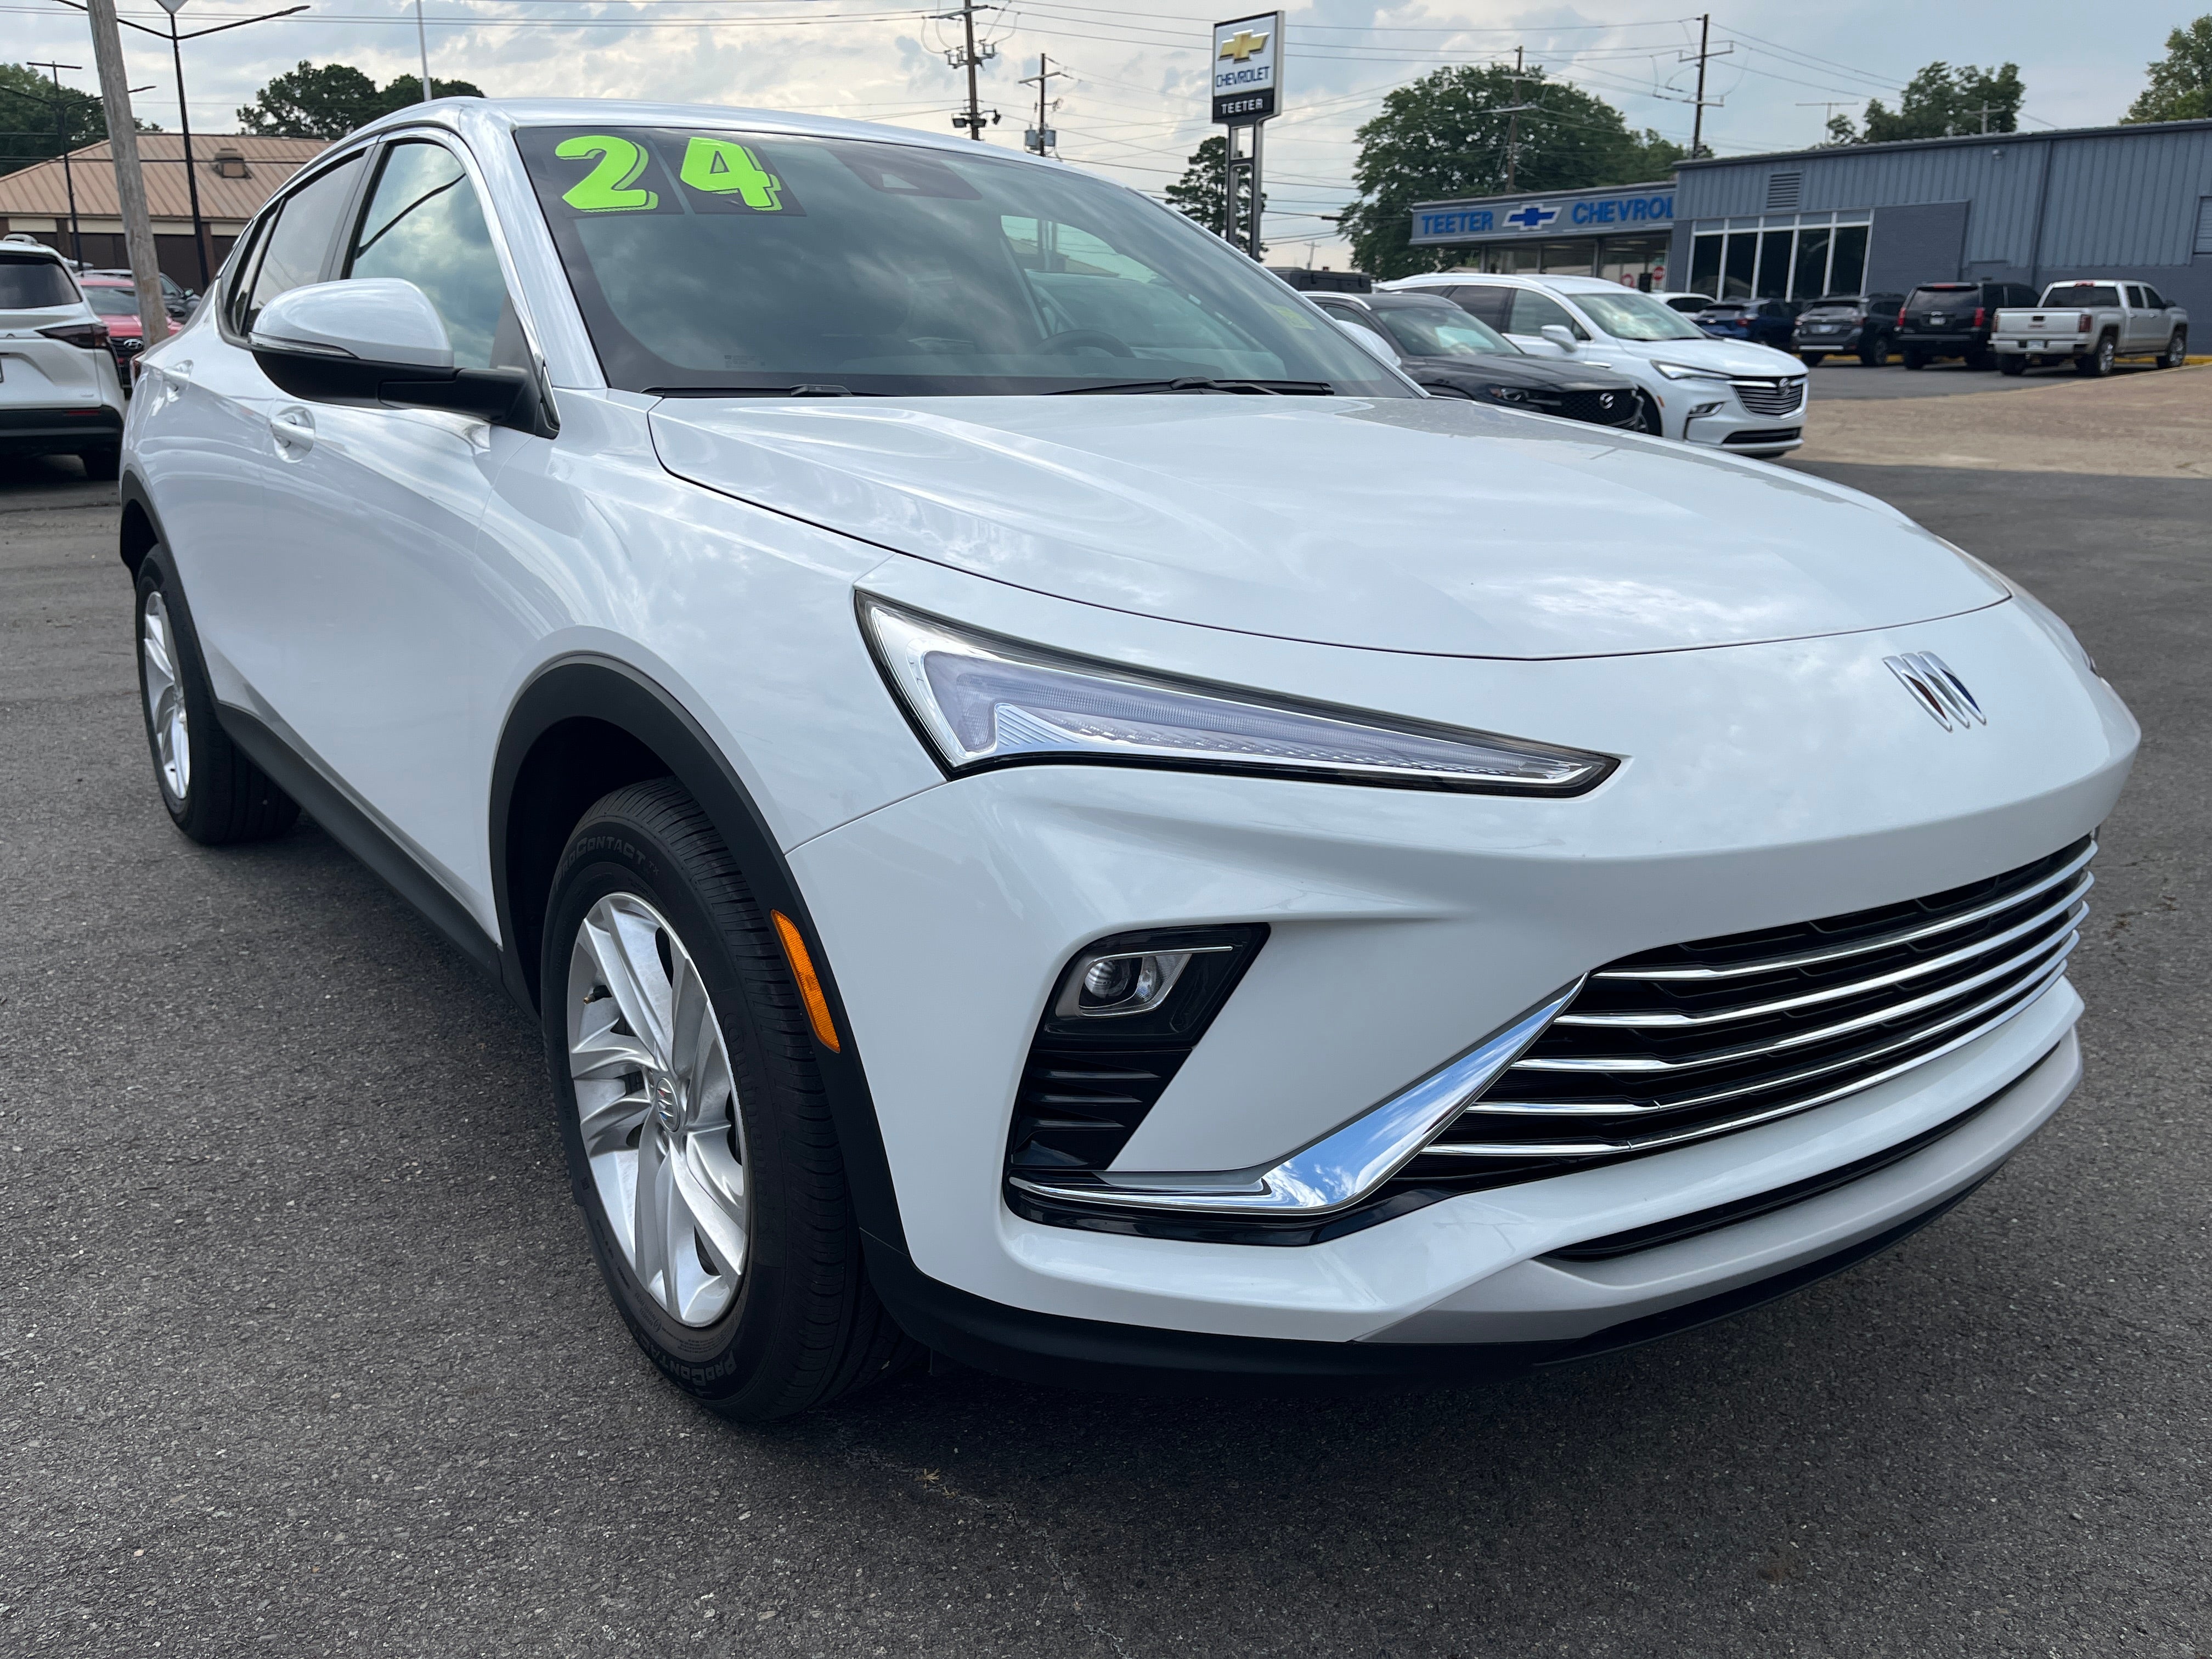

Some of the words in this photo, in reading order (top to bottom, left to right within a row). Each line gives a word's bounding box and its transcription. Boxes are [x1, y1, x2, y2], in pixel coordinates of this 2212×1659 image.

[1216, 66, 1270, 87] CHEVROLET
[1222, 99, 1263, 114] TEETER
[1421, 210, 1493, 234] TEETER
